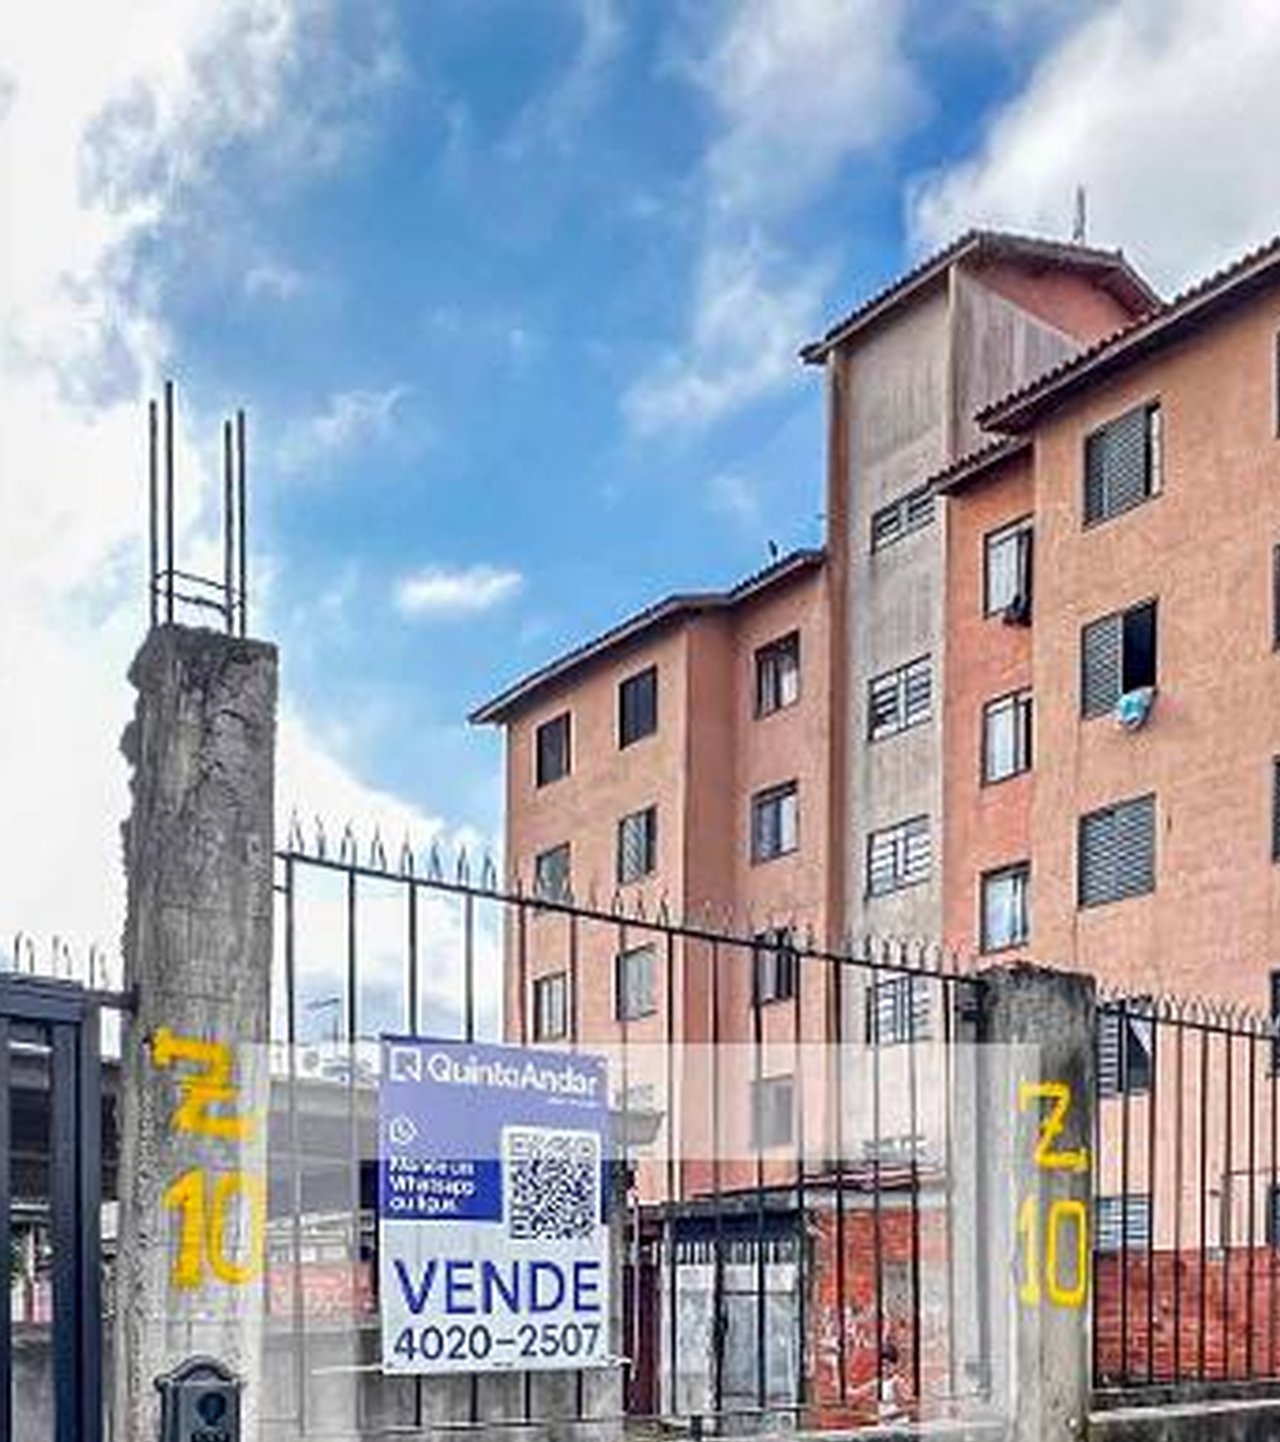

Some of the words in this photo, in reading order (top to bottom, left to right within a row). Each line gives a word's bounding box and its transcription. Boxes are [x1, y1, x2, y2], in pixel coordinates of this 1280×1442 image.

[427, 1052, 598, 1096] QuintoAndar
[1017, 1080, 1090, 1173] Z
[162, 1167, 267, 1288] 10
[1018, 1195, 1088, 1308] 10
[393, 1259, 601, 1314] VENDE
[393, 1323, 601, 1360] 4020-2507
